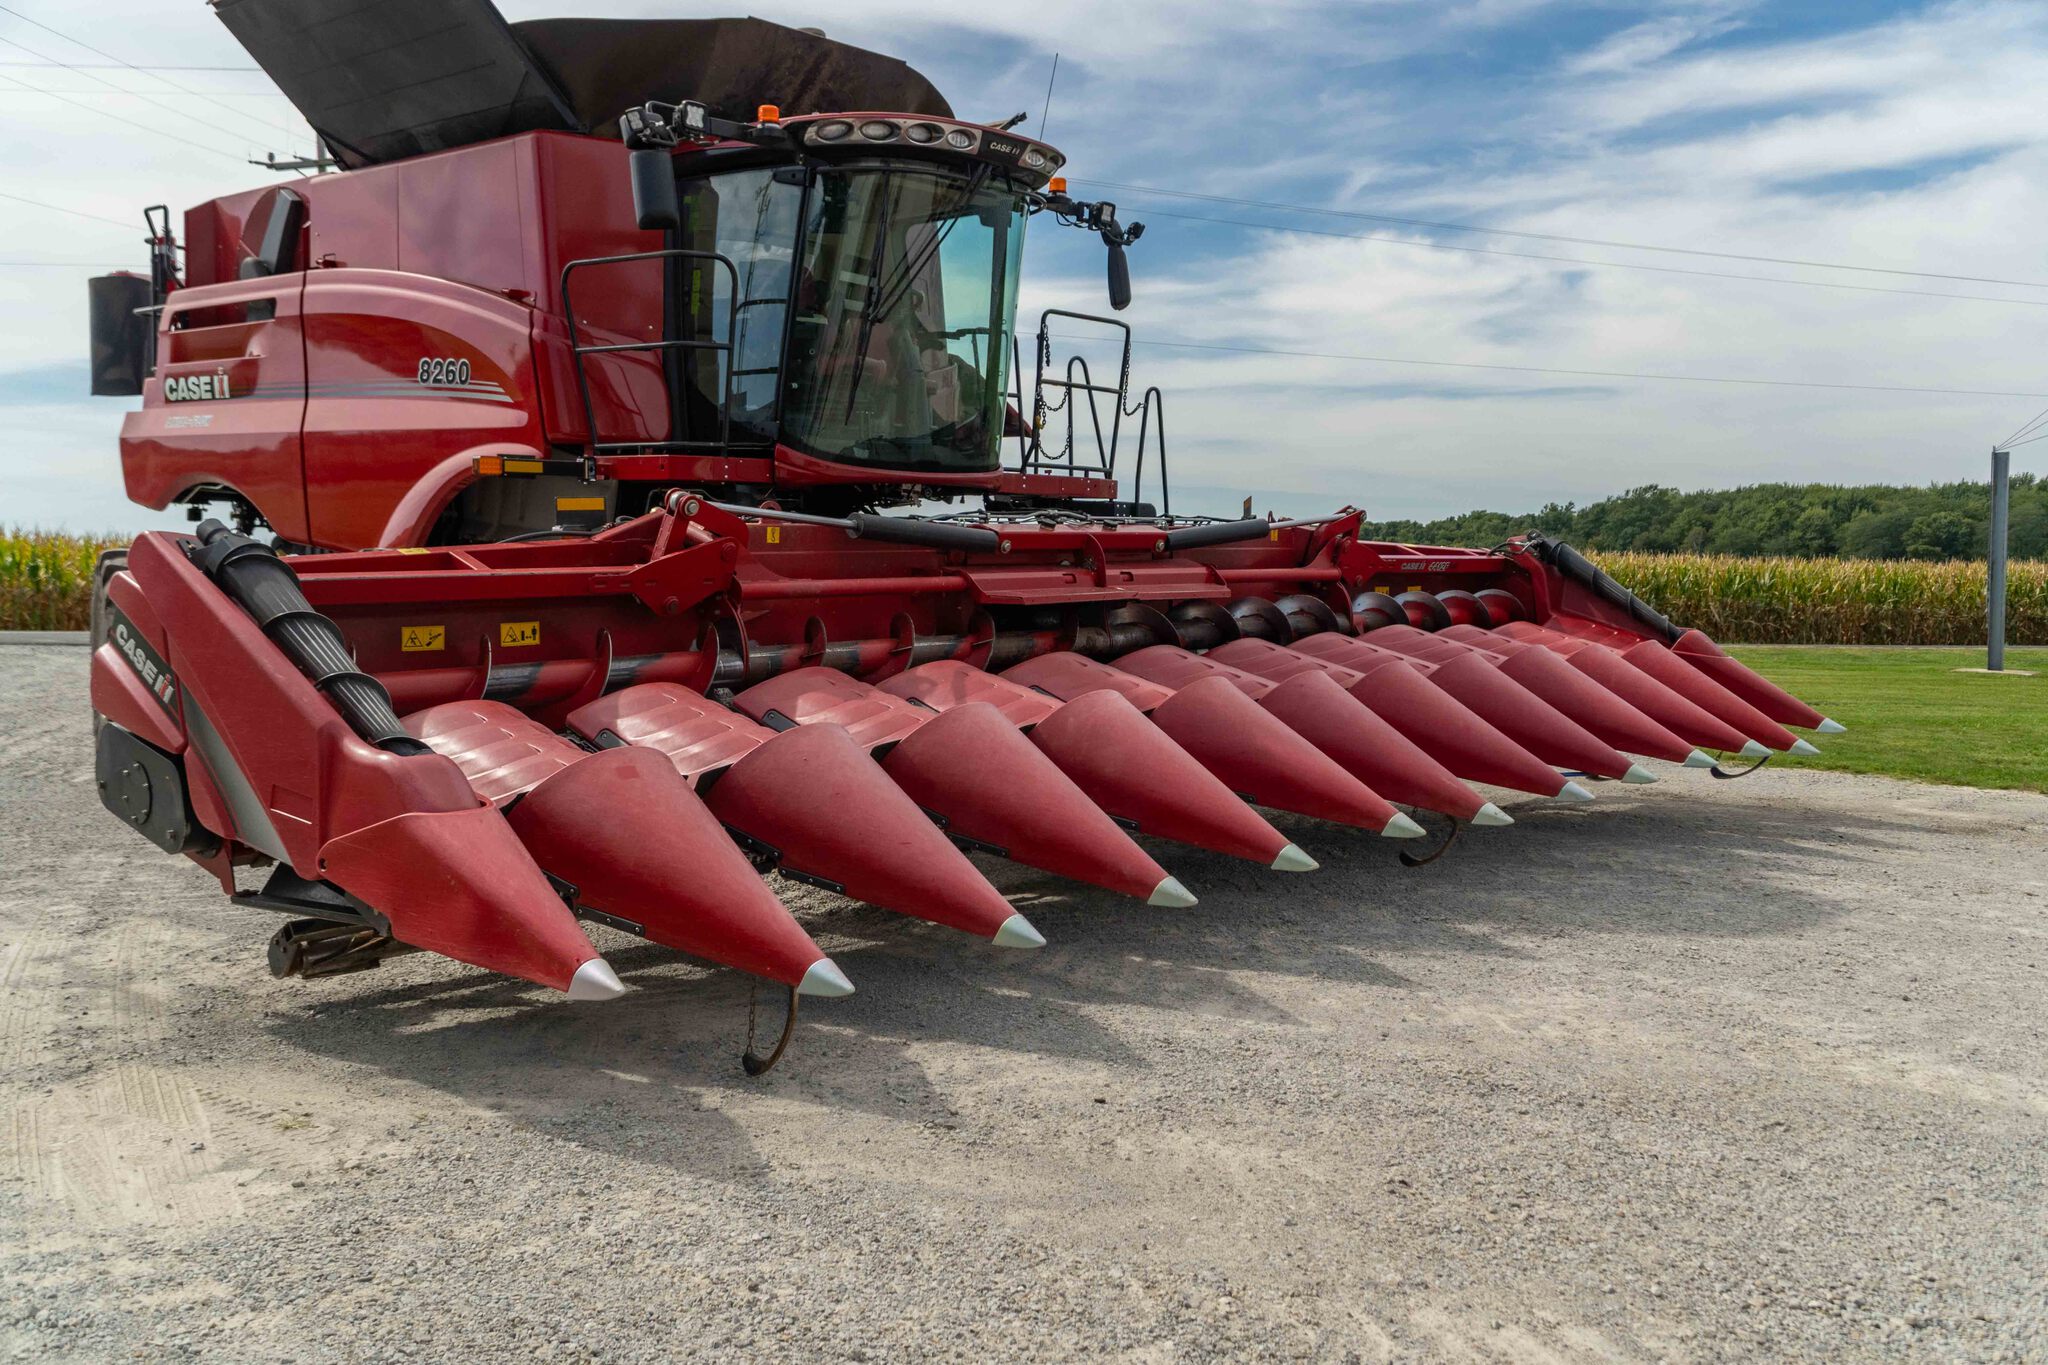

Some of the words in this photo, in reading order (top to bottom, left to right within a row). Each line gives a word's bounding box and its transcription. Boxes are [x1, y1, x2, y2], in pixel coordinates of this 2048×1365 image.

[990, 142, 1012, 154] CASE
[418, 357, 471, 386] 8260
[165, 375, 213, 401] CASE
[116, 623, 158, 685] CASE
